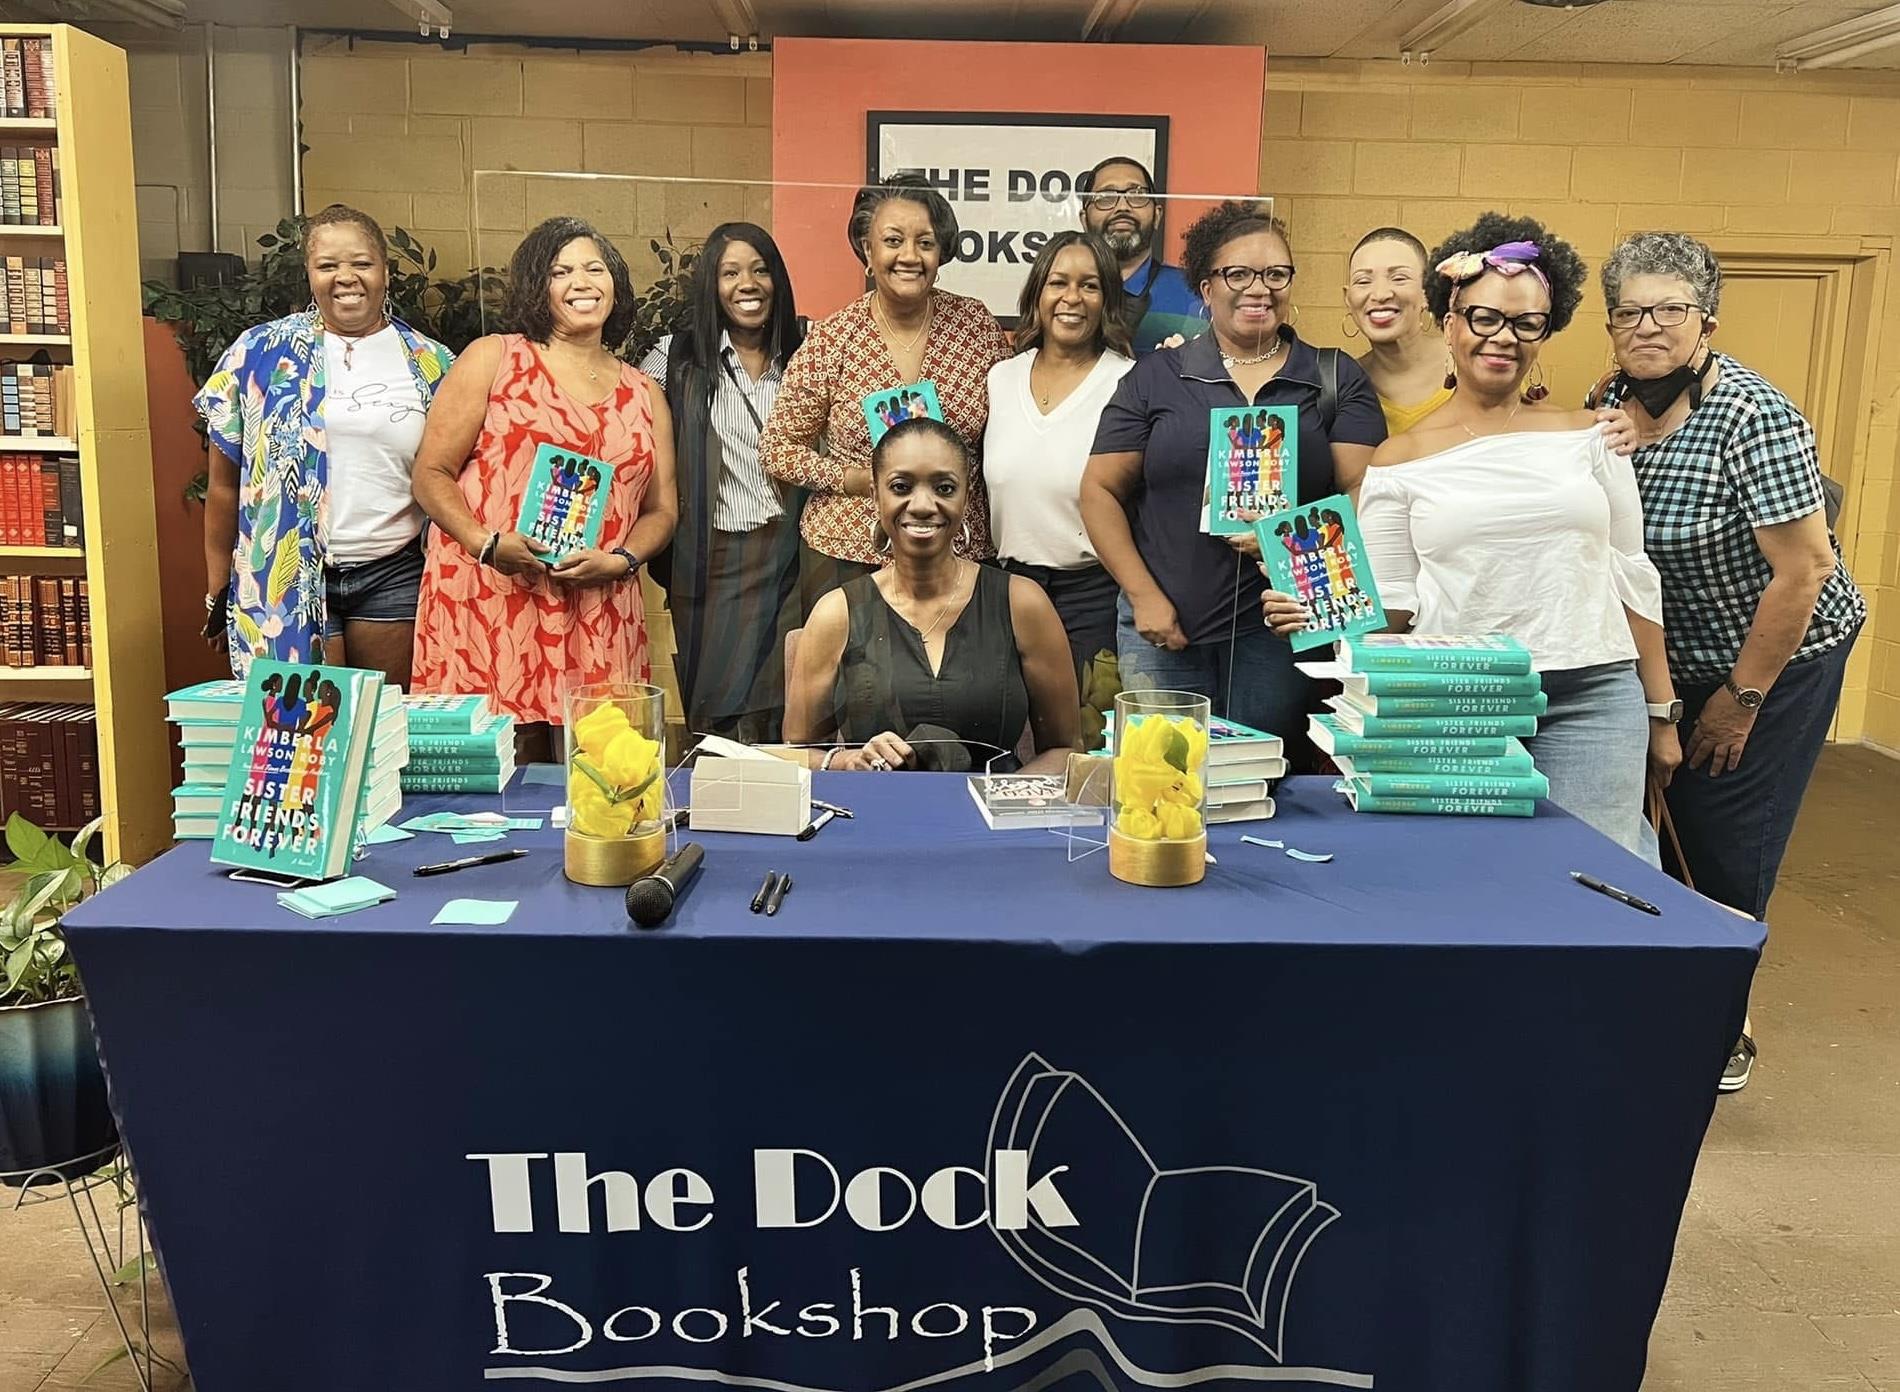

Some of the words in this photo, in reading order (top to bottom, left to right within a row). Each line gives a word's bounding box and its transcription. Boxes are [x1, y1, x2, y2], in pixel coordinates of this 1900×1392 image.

[1218, 448, 1290, 459] KIMBERLA
[1227, 480, 1280, 492] SISTER
[1221, 494, 1288, 507] FRIENDS
[1278, 542, 1356, 571] KIMBERLA
[1299, 578, 1355, 602] SISTER
[1300, 606, 1375, 636] OREVER
[1433, 662, 1491, 671] FOREVER
[1448, 685, 1503, 693] FOREVER
[1455, 705, 1509, 713] FOREVER
[1442, 726, 1497, 735] FOREVER
[243, 726, 338, 753] KIMBERLA
[241, 743, 295, 761] LAWSON
[300, 754, 336, 767] ROBY
[410, 746, 458, 754] OREVER
[1413, 746, 1469, 754] FOREVER
[1435, 765, 1492, 773] FOREVER
[243, 778, 315, 806] SISTER
[405, 784, 461, 792] FOREVER
[1452, 788, 1509, 796] FOREVER
[1438, 805, 1495, 813] FOREVER
[230, 800, 320, 832] FRIENDS
[222, 823, 318, 856] FOREVER
[465, 1152, 715, 1233] The
[754, 1148, 1081, 1232] Dock
[482, 1266, 1038, 1373] Bookshop
